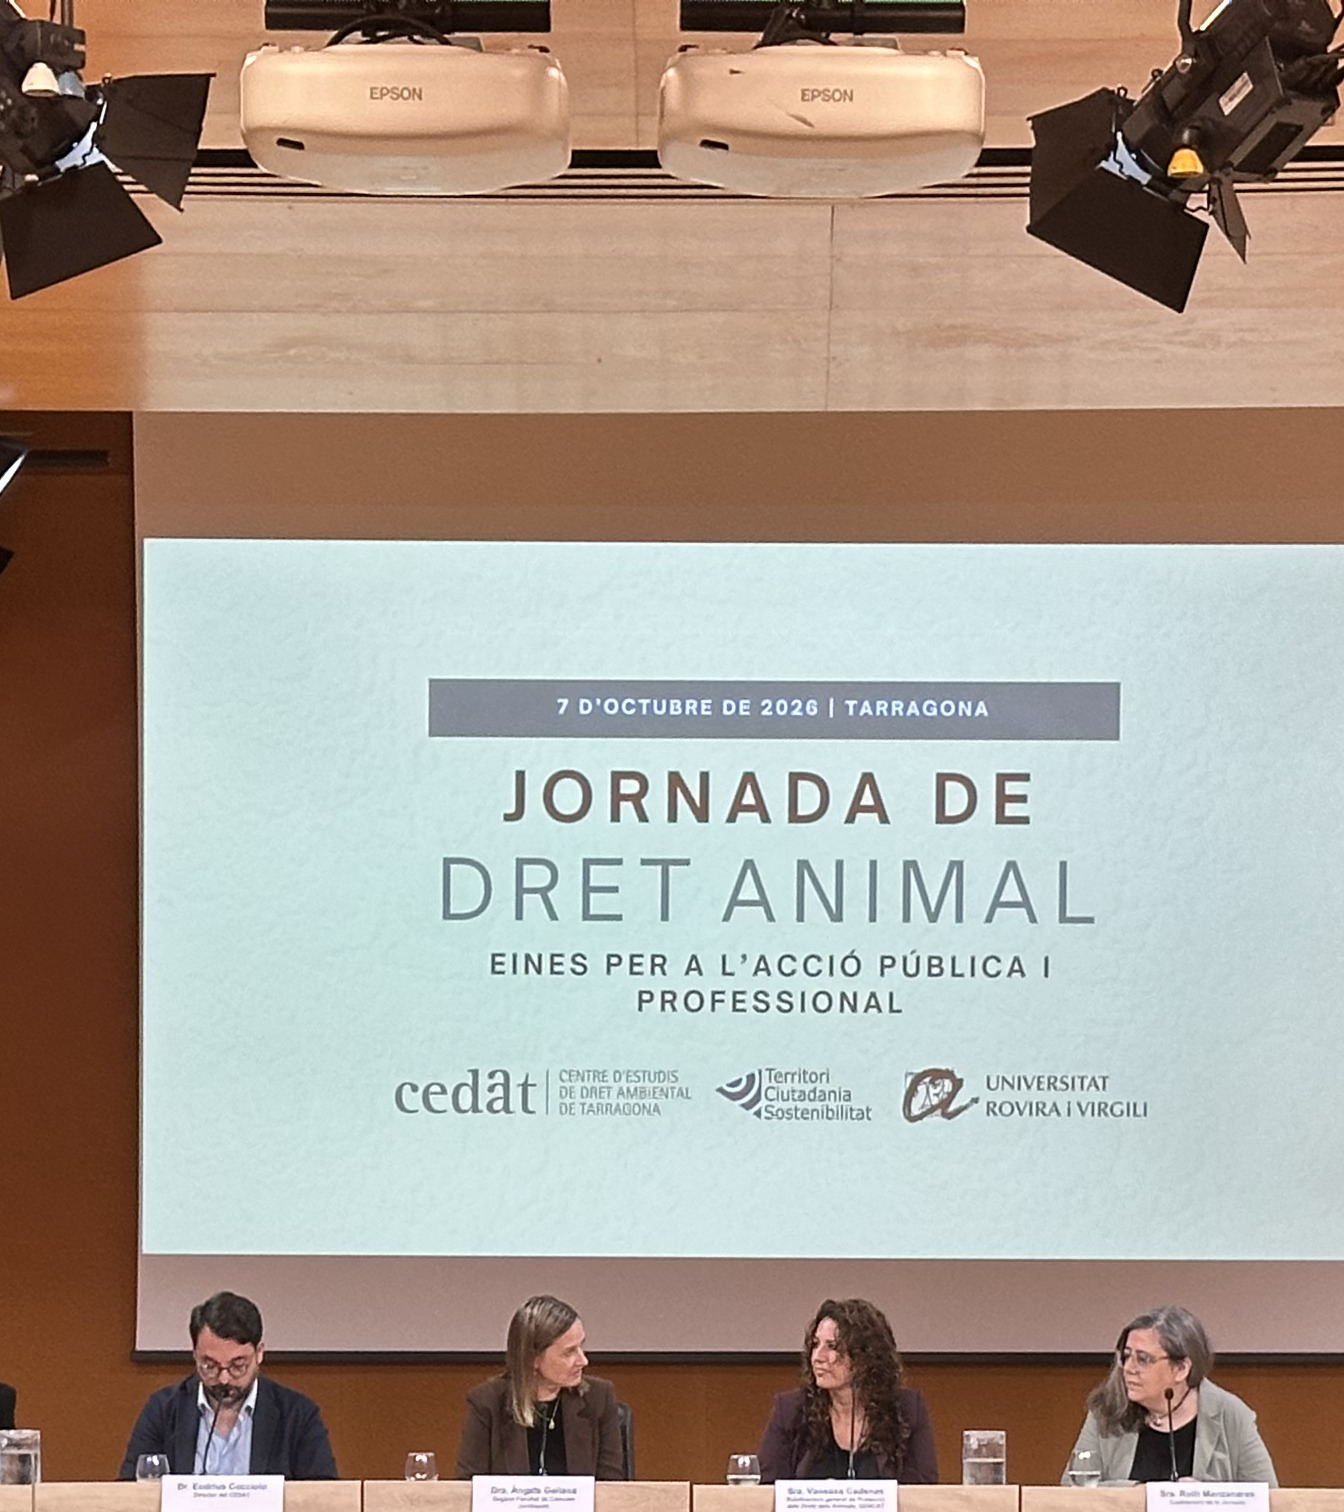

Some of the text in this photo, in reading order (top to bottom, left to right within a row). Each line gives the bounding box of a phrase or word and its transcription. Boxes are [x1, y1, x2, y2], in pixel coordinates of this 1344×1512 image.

[369, 86, 423, 102] EPSON
[800, 87, 854, 103] EPSON
[556, 698, 569, 715] 7
[578, 697, 713, 716] D'OCTUBRE
[722, 699, 751, 716] DE
[760, 698, 819, 717] 2026
[844, 699, 990, 717] TARRAGONA
[502, 769, 1032, 826] JORNADA DE
[441, 856, 1097, 925] DRET ANIMAL
[490, 948, 1050, 980] EINES PER A L'ACCIÓ PÚBLICA I
[637, 989, 904, 1015] PROFESSIONAL
[558, 1069, 680, 1084] CENTRE D'ESTUDIS
[764, 1067, 830, 1084] Territori
[986, 1074, 1111, 1092] UNIVERSITAT
[559, 1085, 692, 1101] DE DRET AMBIENTAL
[764, 1085, 853, 1103] Ciutadania
[559, 1101, 662, 1117] DE TARRAGONA
[763, 1104, 873, 1121] Sostenibilitat
[986, 1100, 1062, 1118] ROVIRA
[1076, 1101, 1149, 1119] VIRGILI
